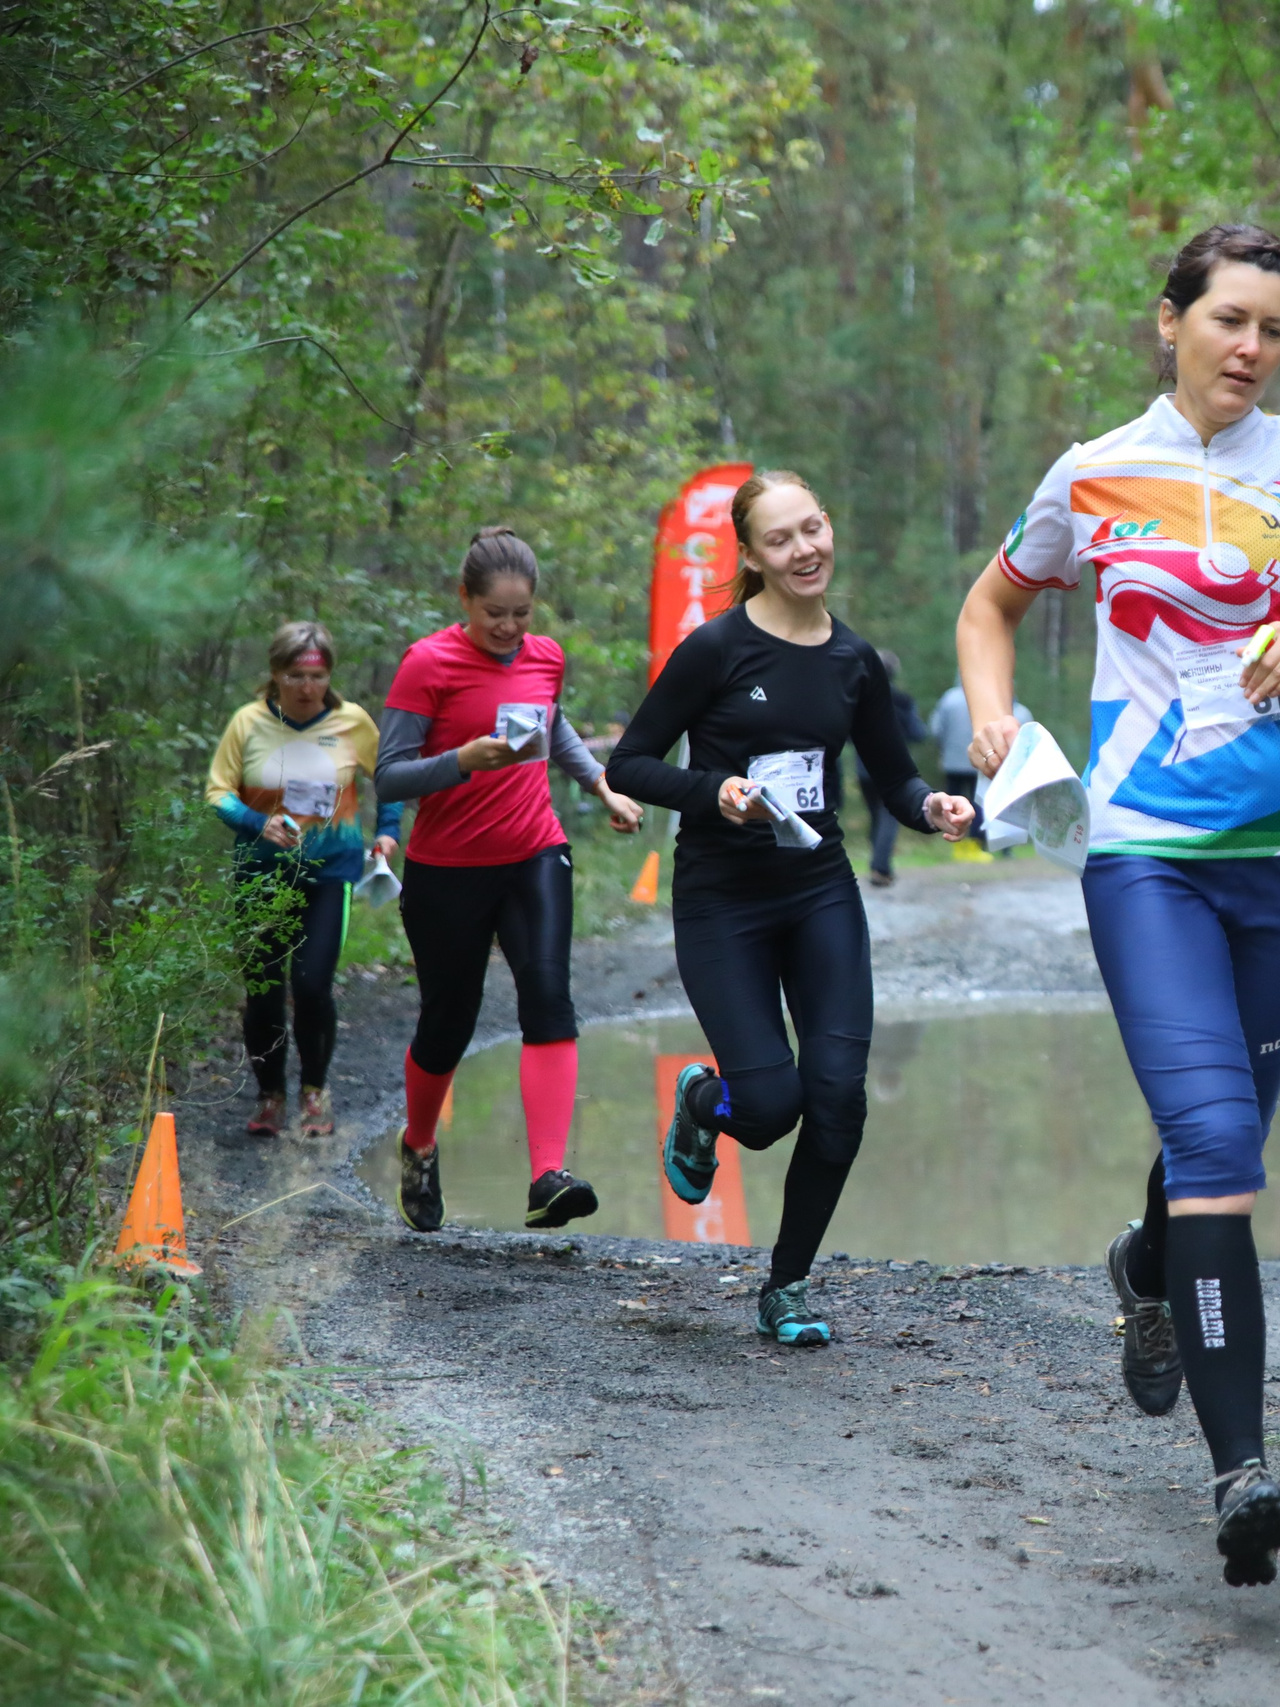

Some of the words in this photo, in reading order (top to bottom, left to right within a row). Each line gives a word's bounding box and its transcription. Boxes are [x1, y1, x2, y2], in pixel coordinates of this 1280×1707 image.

[677, 531, 719, 643] СТА
[1179, 664, 1223, 679] ЖЕНЩИНЫ
[796, 786, 820, 809] 62
